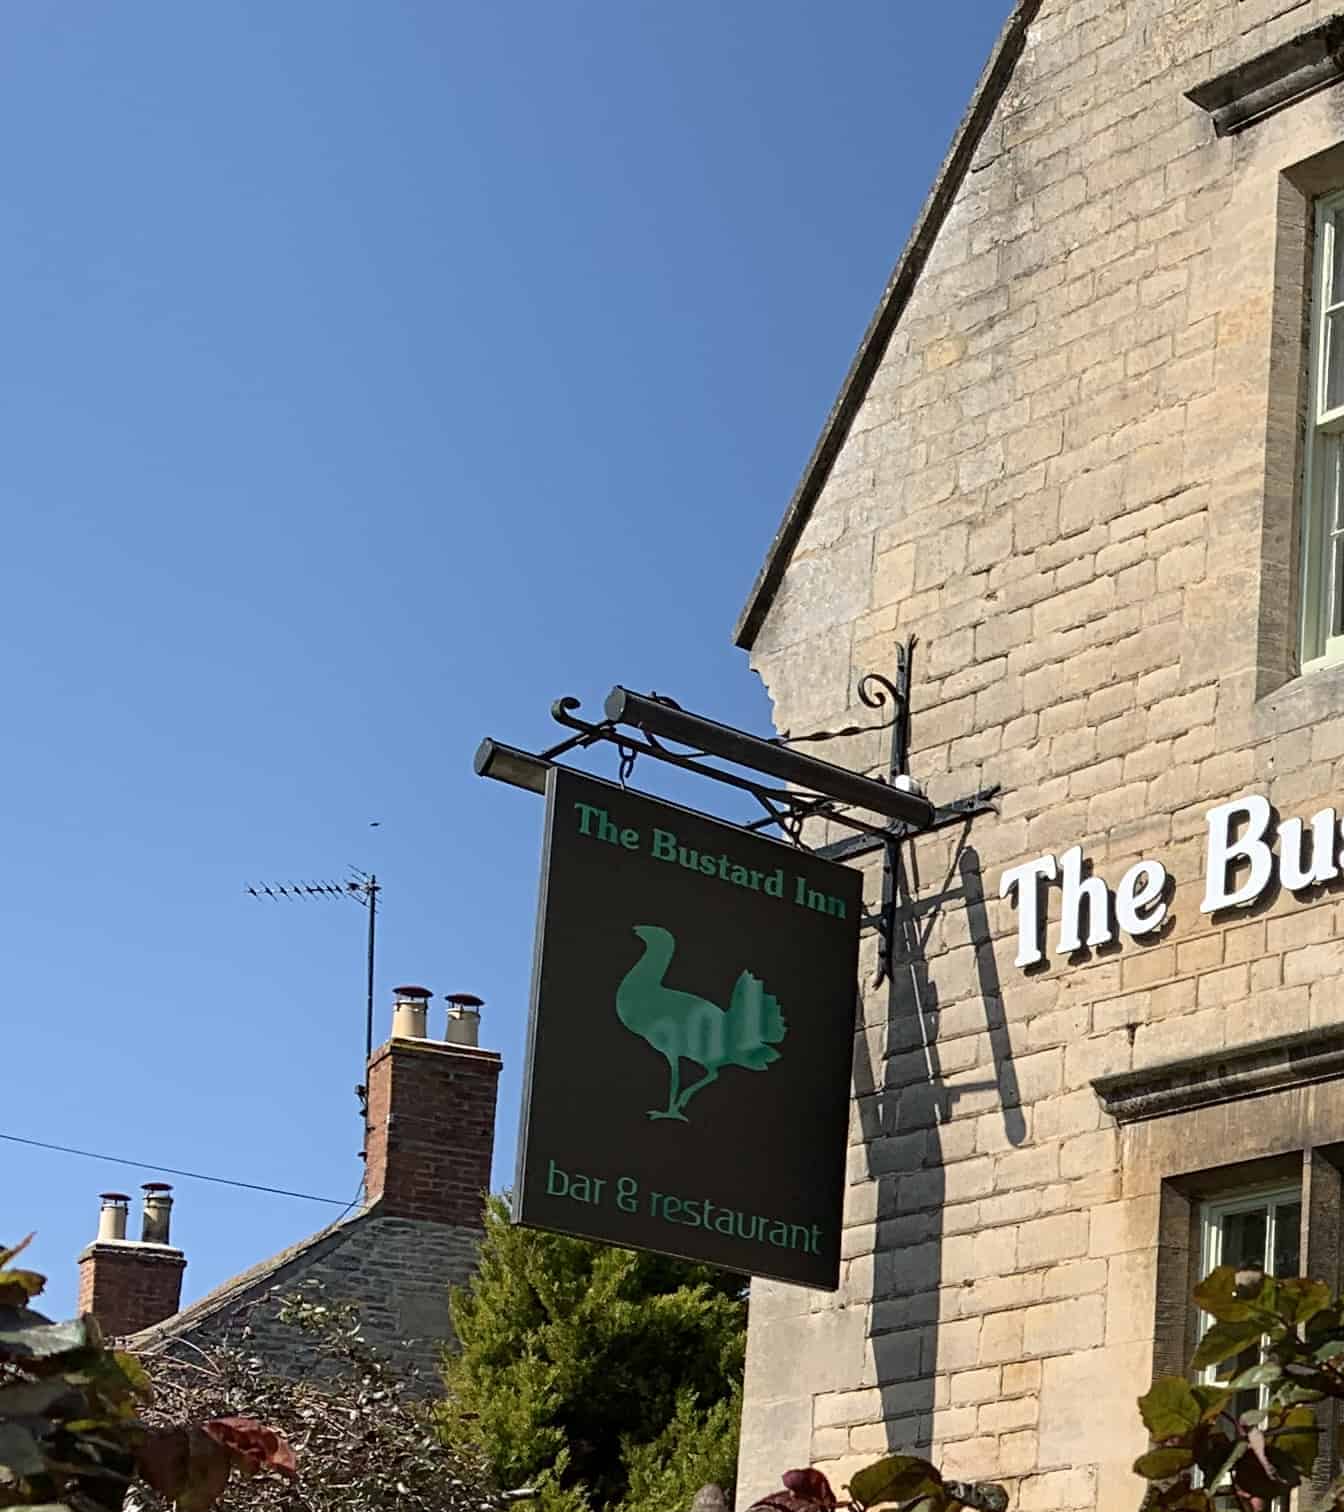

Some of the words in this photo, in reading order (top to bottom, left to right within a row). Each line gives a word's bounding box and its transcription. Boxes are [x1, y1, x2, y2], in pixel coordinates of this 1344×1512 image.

[574, 802, 640, 849] The
[651, 827, 784, 898] Bustard
[793, 876, 847, 919] Inn
[1000, 845, 1167, 968] The
[545, 1159, 606, 1204] bar
[615, 1176, 638, 1213] &
[650, 1190, 824, 1255] restaurant
